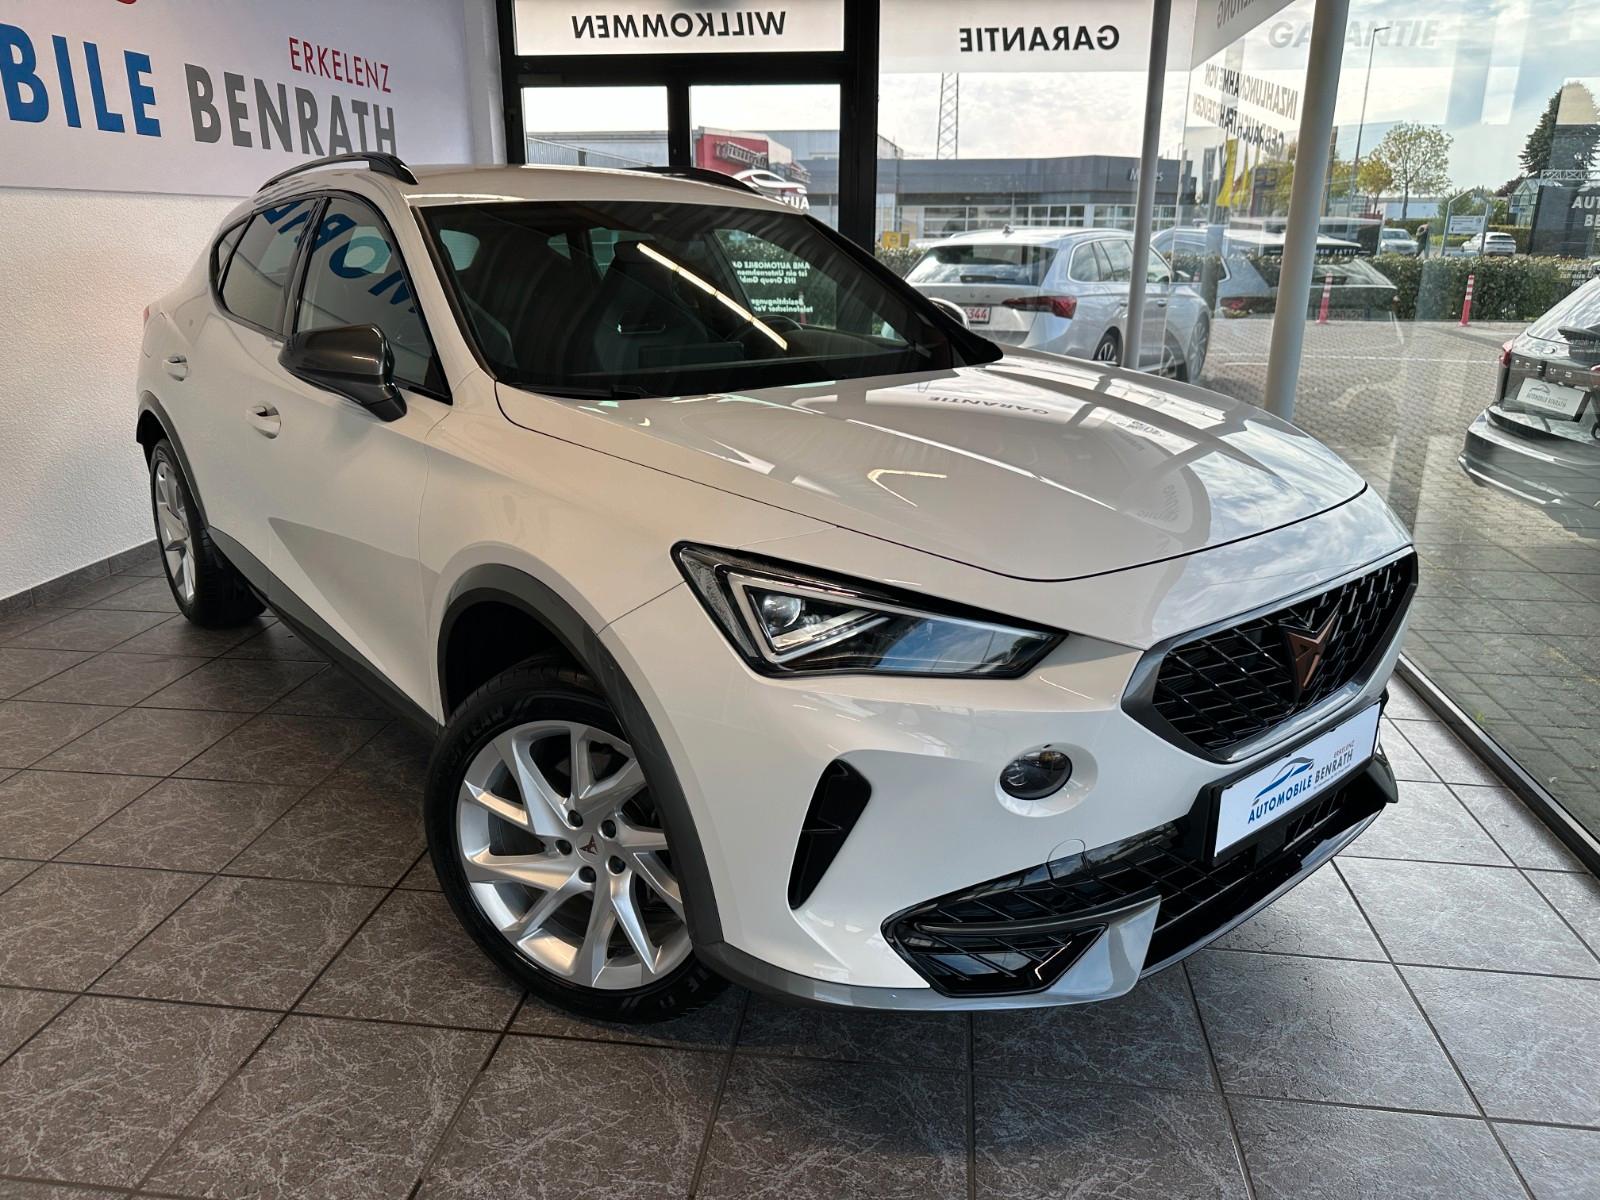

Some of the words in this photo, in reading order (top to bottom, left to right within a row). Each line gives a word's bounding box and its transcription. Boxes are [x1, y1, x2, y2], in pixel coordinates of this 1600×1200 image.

[1268, 20, 1440, 48] GAANTIE
[0, 23, 162, 137] BILE
[184, 63, 398, 157] BENRATH
[288, 37, 392, 93] ERKELENZ
[966, 308, 987, 320] 344
[1247, 774, 1313, 824] AUTOMOBILE
[1314, 748, 1353, 784] BENRATH
